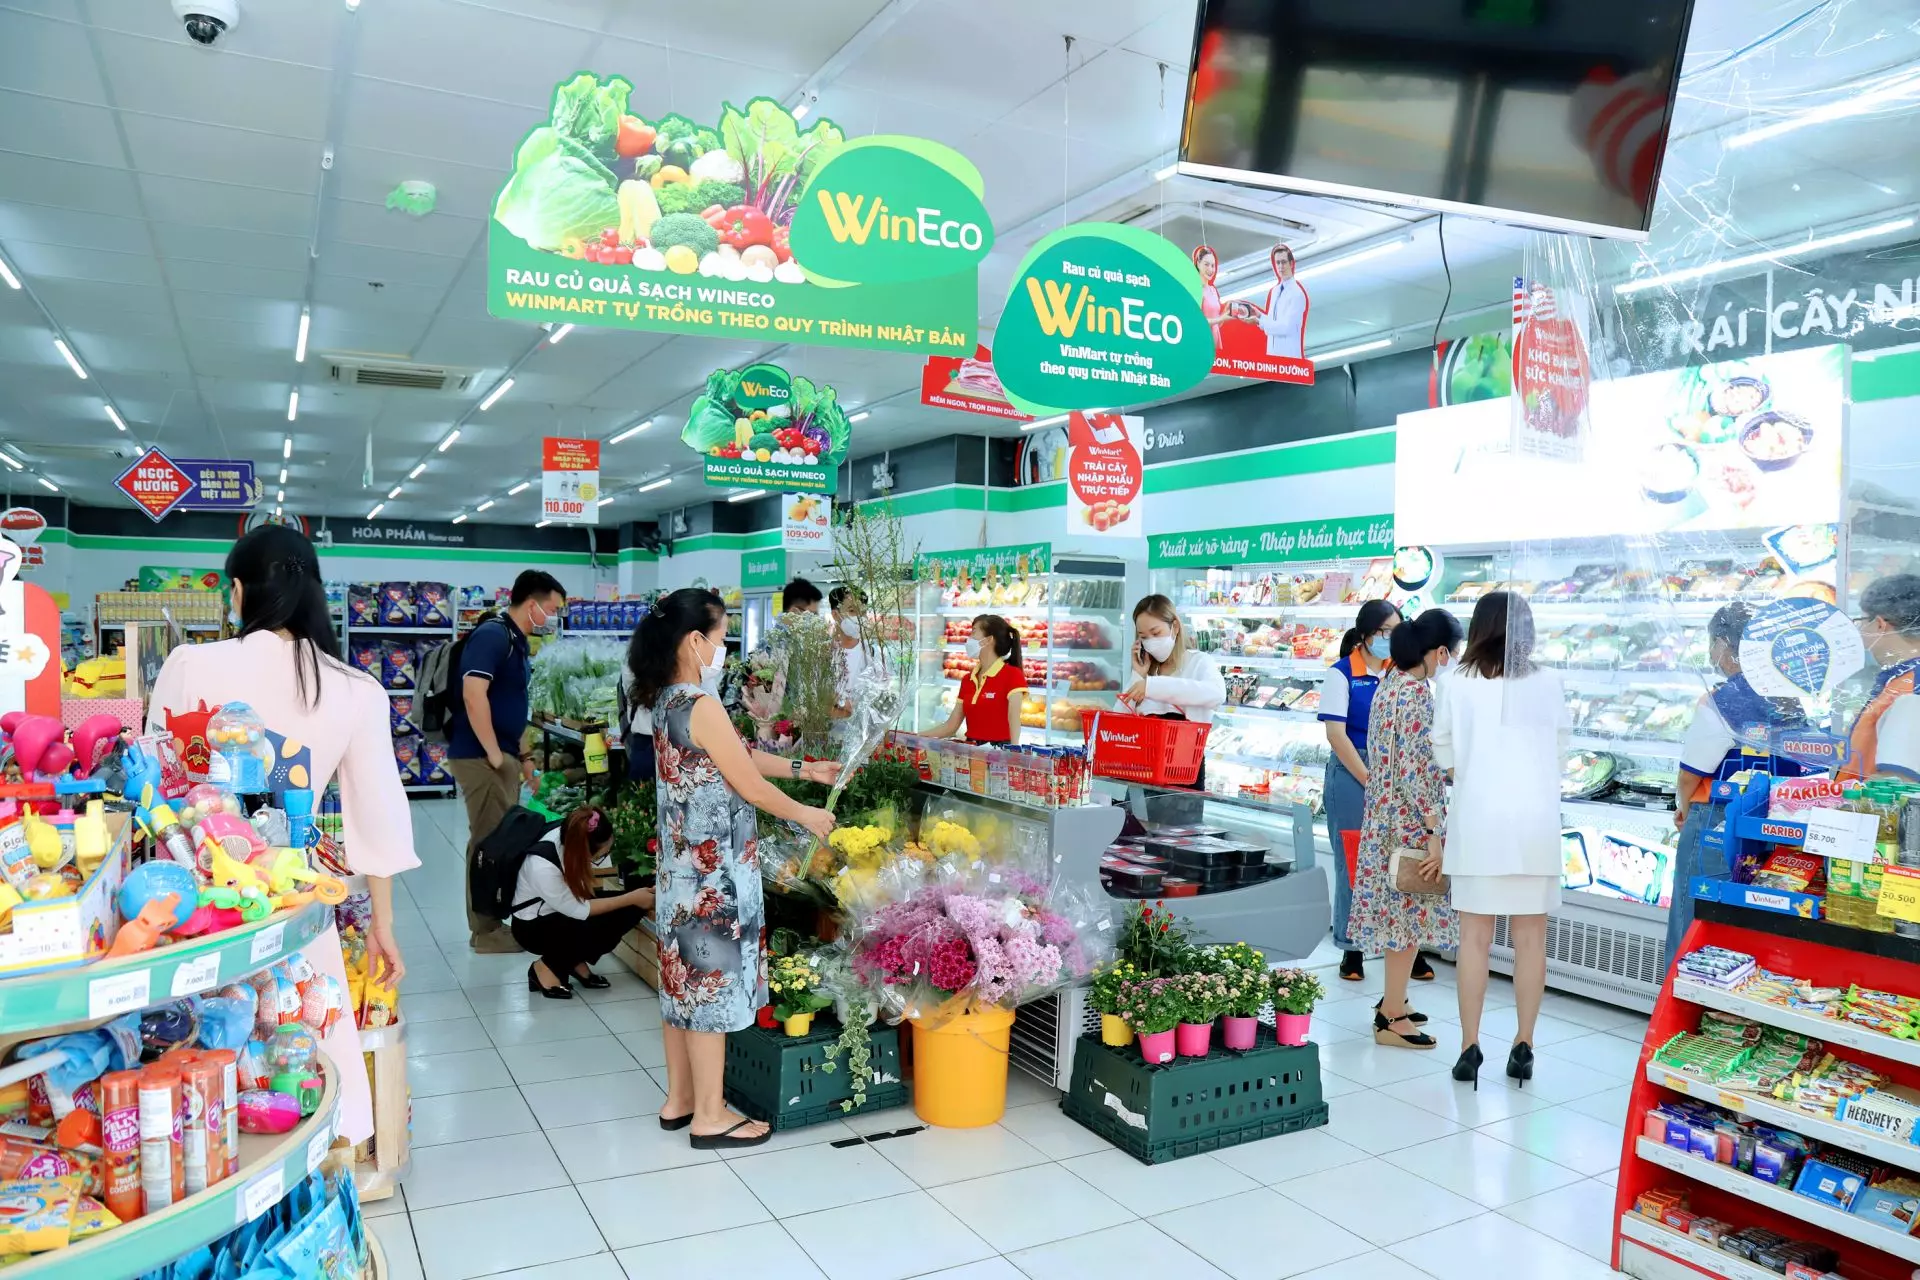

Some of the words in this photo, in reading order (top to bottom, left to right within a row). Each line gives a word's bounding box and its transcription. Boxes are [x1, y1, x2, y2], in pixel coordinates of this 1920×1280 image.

[817, 189, 982, 251] WinEco
[1062, 260, 1085, 277] Rau
[1088, 264, 1101, 279] củ
[1103, 268, 1123, 284] quả
[1125, 272, 1151, 288] sạch
[505, 268, 549, 287] RAU
[554, 269, 583, 290] CỦ
[588, 274, 634, 295] QUẢ
[638, 281, 692, 302] SẠCH
[696, 286, 776, 309] WINECO
[505, 291, 608, 316] WINMART
[612, 300, 640, 321] TỰ
[644, 301, 714, 325] TRỒNG
[718, 311, 769, 329] THEO
[774, 316, 814, 333] QUY
[818, 318, 873, 339] TRÌNH
[877, 325, 924, 346] NHẬT
[928, 325, 965, 347] BẢN
[1026, 276, 1183, 345] WinEco
[1772, 287, 1858, 340] CÂY
[1060, 343, 1108, 362] VinMart
[1110, 350, 1121, 366] tự
[1124, 350, 1153, 369] trồng
[1040, 361, 1065, 376] theo
[1068, 366, 1089, 380] quy
[1121, 370, 1148, 387] Nhật
[1150, 372, 1171, 388] Bản
[1232, 359, 1255, 372] TRỌN
[1256, 363, 1278, 374] DINH
[1278, 364, 1310, 377] DƯỠNG
[741, 381, 789, 398] WinEco
[946, 398, 968, 409] NGON,
[986, 404, 1003, 414] DINH
[1157, 429, 1185, 449] Drink
[138, 467, 174, 480] NGỌC
[706, 464, 727, 473] RAU
[728, 464, 741, 474] CỦ
[743, 465, 763, 476] QUẢ
[764, 469, 789, 479] SẠCH
[790, 470, 826, 480] WINECO
[1083, 459, 1106, 471] TRÁI
[1107, 460, 1128, 472] CÂY
[1076, 472, 1105, 485] NHẬP
[200, 490, 219, 500] VIỆT
[220, 490, 241, 499] NAM
[1080, 485, 1107, 496] TRỰC
[1108, 483, 1130, 496] TIẾP
[385, 524, 426, 541] PHẨM
[1159, 534, 1187, 558] Xuất
[1188, 536, 1202, 556] xứ
[1205, 537, 1218, 555] rõ
[1220, 535, 1250, 559] ràng
[1259, 529, 1295, 557] Nhập
[1297, 524, 1333, 549] khẩu
[1336, 525, 1365, 551] trực
[1368, 519, 1394, 549] tiếp
[1100, 729, 1136, 744] WinMart
[1783, 740, 1833, 757] HARIBO
[1776, 782, 1844, 801] HARIBO
[1762, 823, 1804, 840] HARIBO
[1808, 832, 1836, 845] 58.700
[1773, 855, 1816, 871] HARIBO
[1882, 890, 1916, 904] 50.500
[104, 1112, 138, 1133] JELLY
[113, 1112, 128, 1120] THE
[1847, 1105, 1902, 1132] HERSHEY'S
[111, 1124, 140, 1143] BEA
